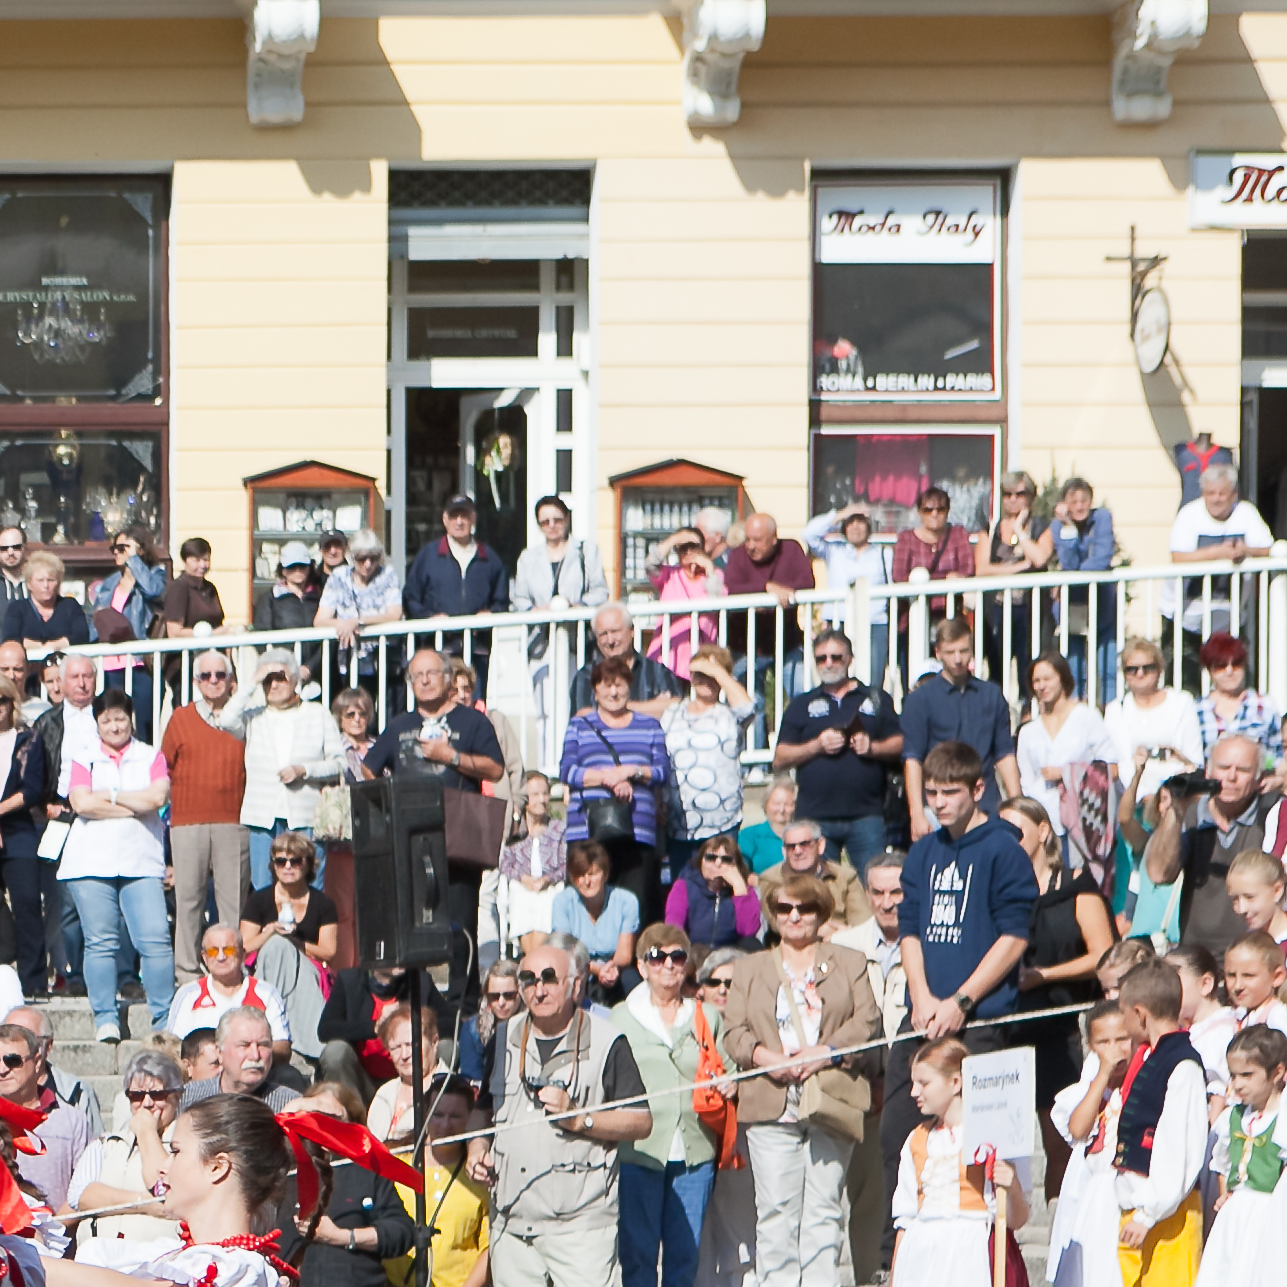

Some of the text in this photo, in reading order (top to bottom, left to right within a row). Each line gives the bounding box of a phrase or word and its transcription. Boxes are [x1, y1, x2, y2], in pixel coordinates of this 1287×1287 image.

[822, 206, 985, 246] Moda Italy
[817, 373, 993, 391] ROMA BERLIN PARIS
[972, 1068, 1020, 1091] Rozmarýnek
